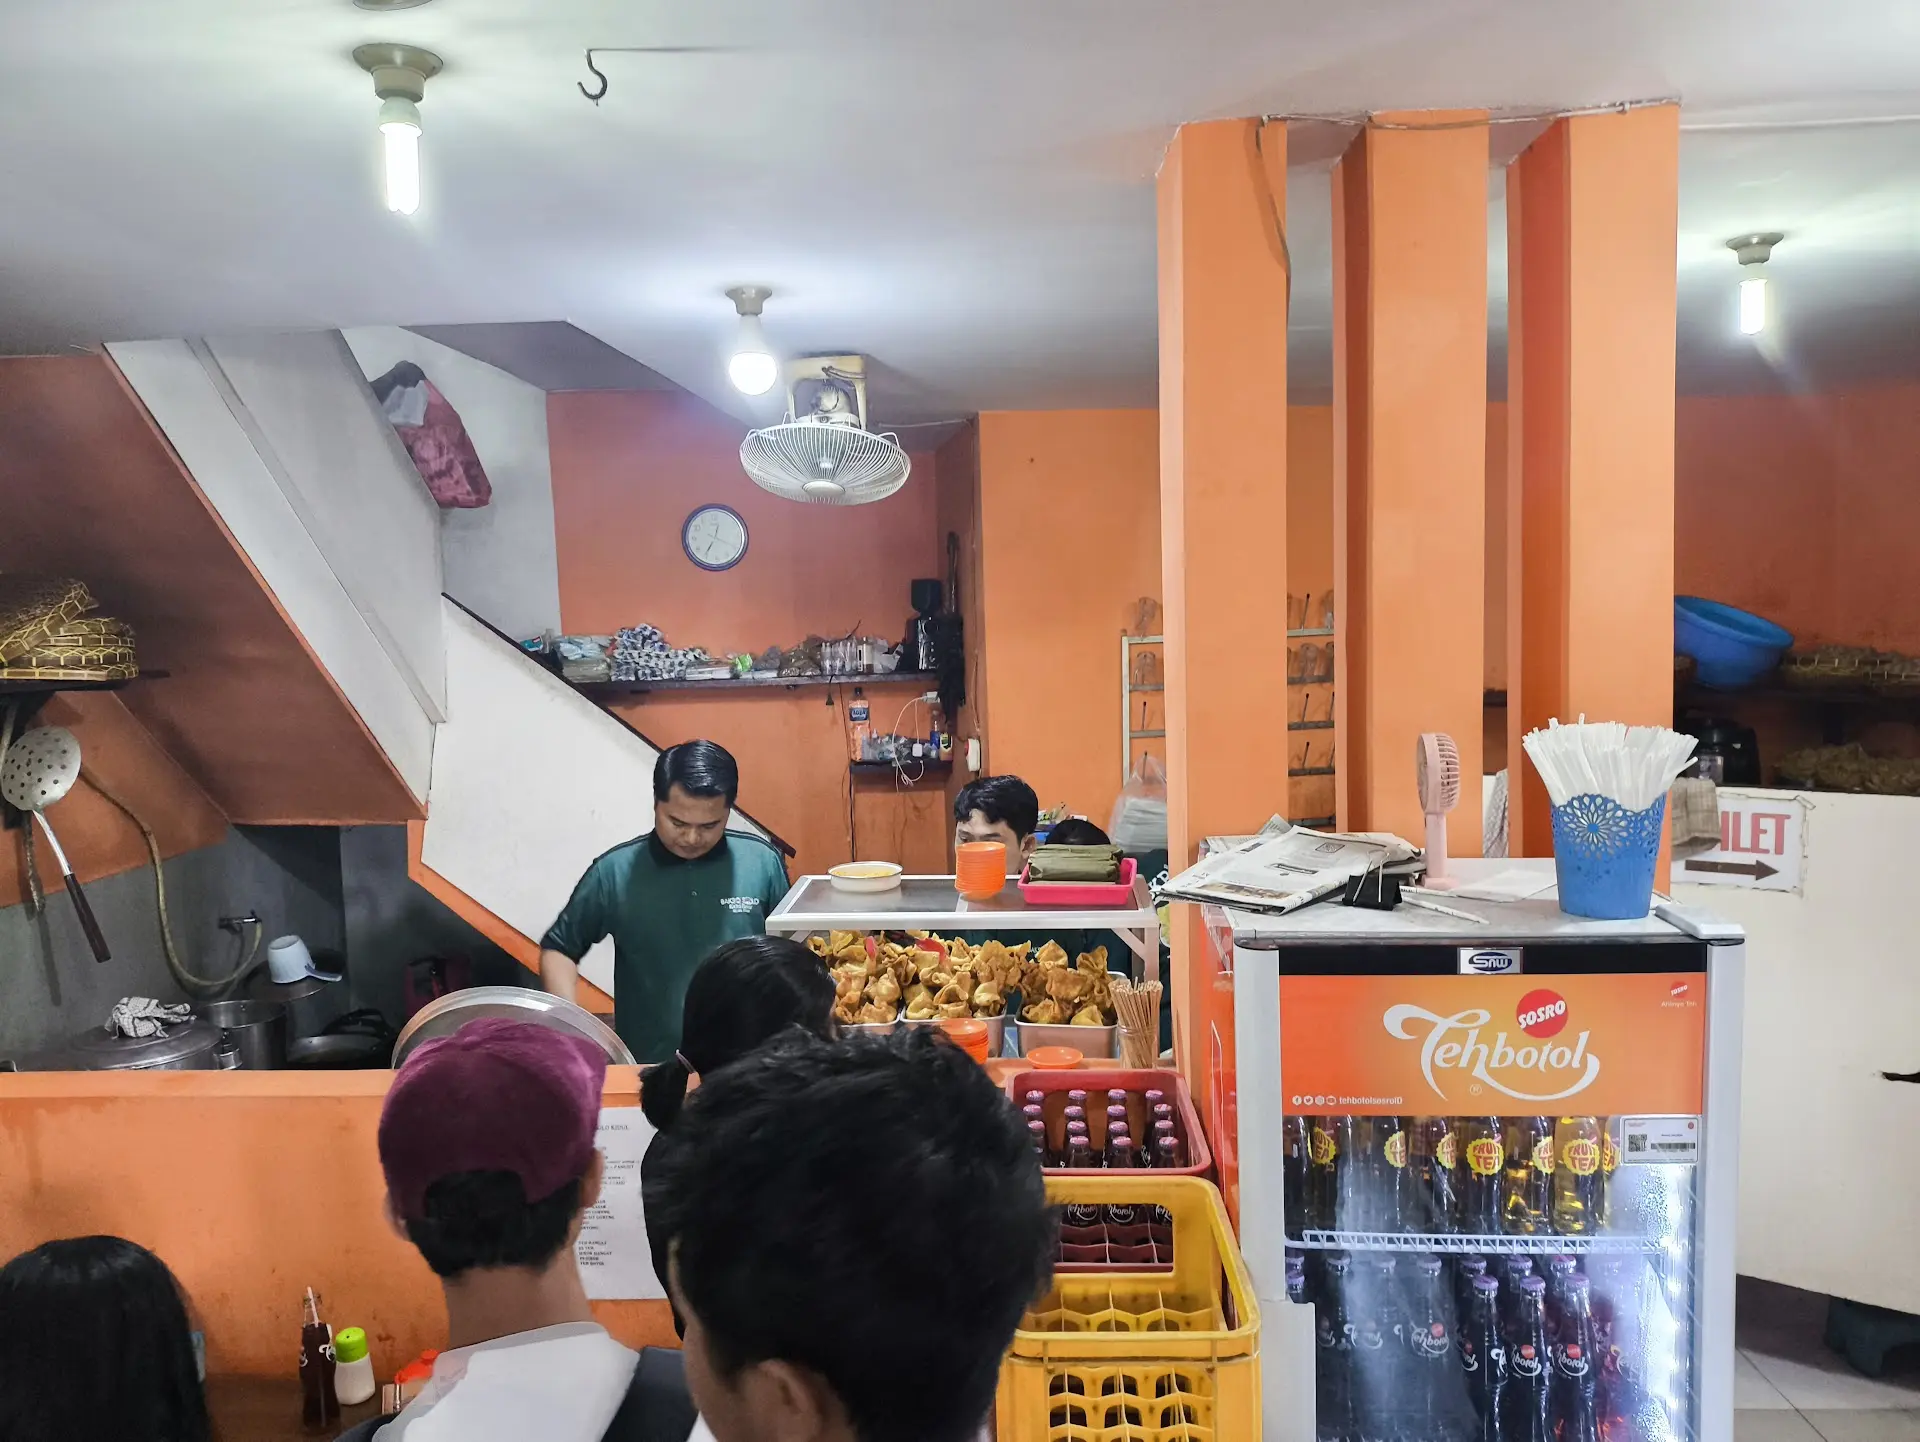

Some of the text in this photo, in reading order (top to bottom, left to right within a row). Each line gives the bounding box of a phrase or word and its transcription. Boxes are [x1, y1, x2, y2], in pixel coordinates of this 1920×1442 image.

[1720, 811, 1791, 855] ILET
[1518, 1000, 1566, 1029] SOSRO
[1383, 1004, 1600, 1101] Tehbotol
[1568, 1144, 1597, 1157] FRUIT
[1570, 1156, 1595, 1171] TEA
